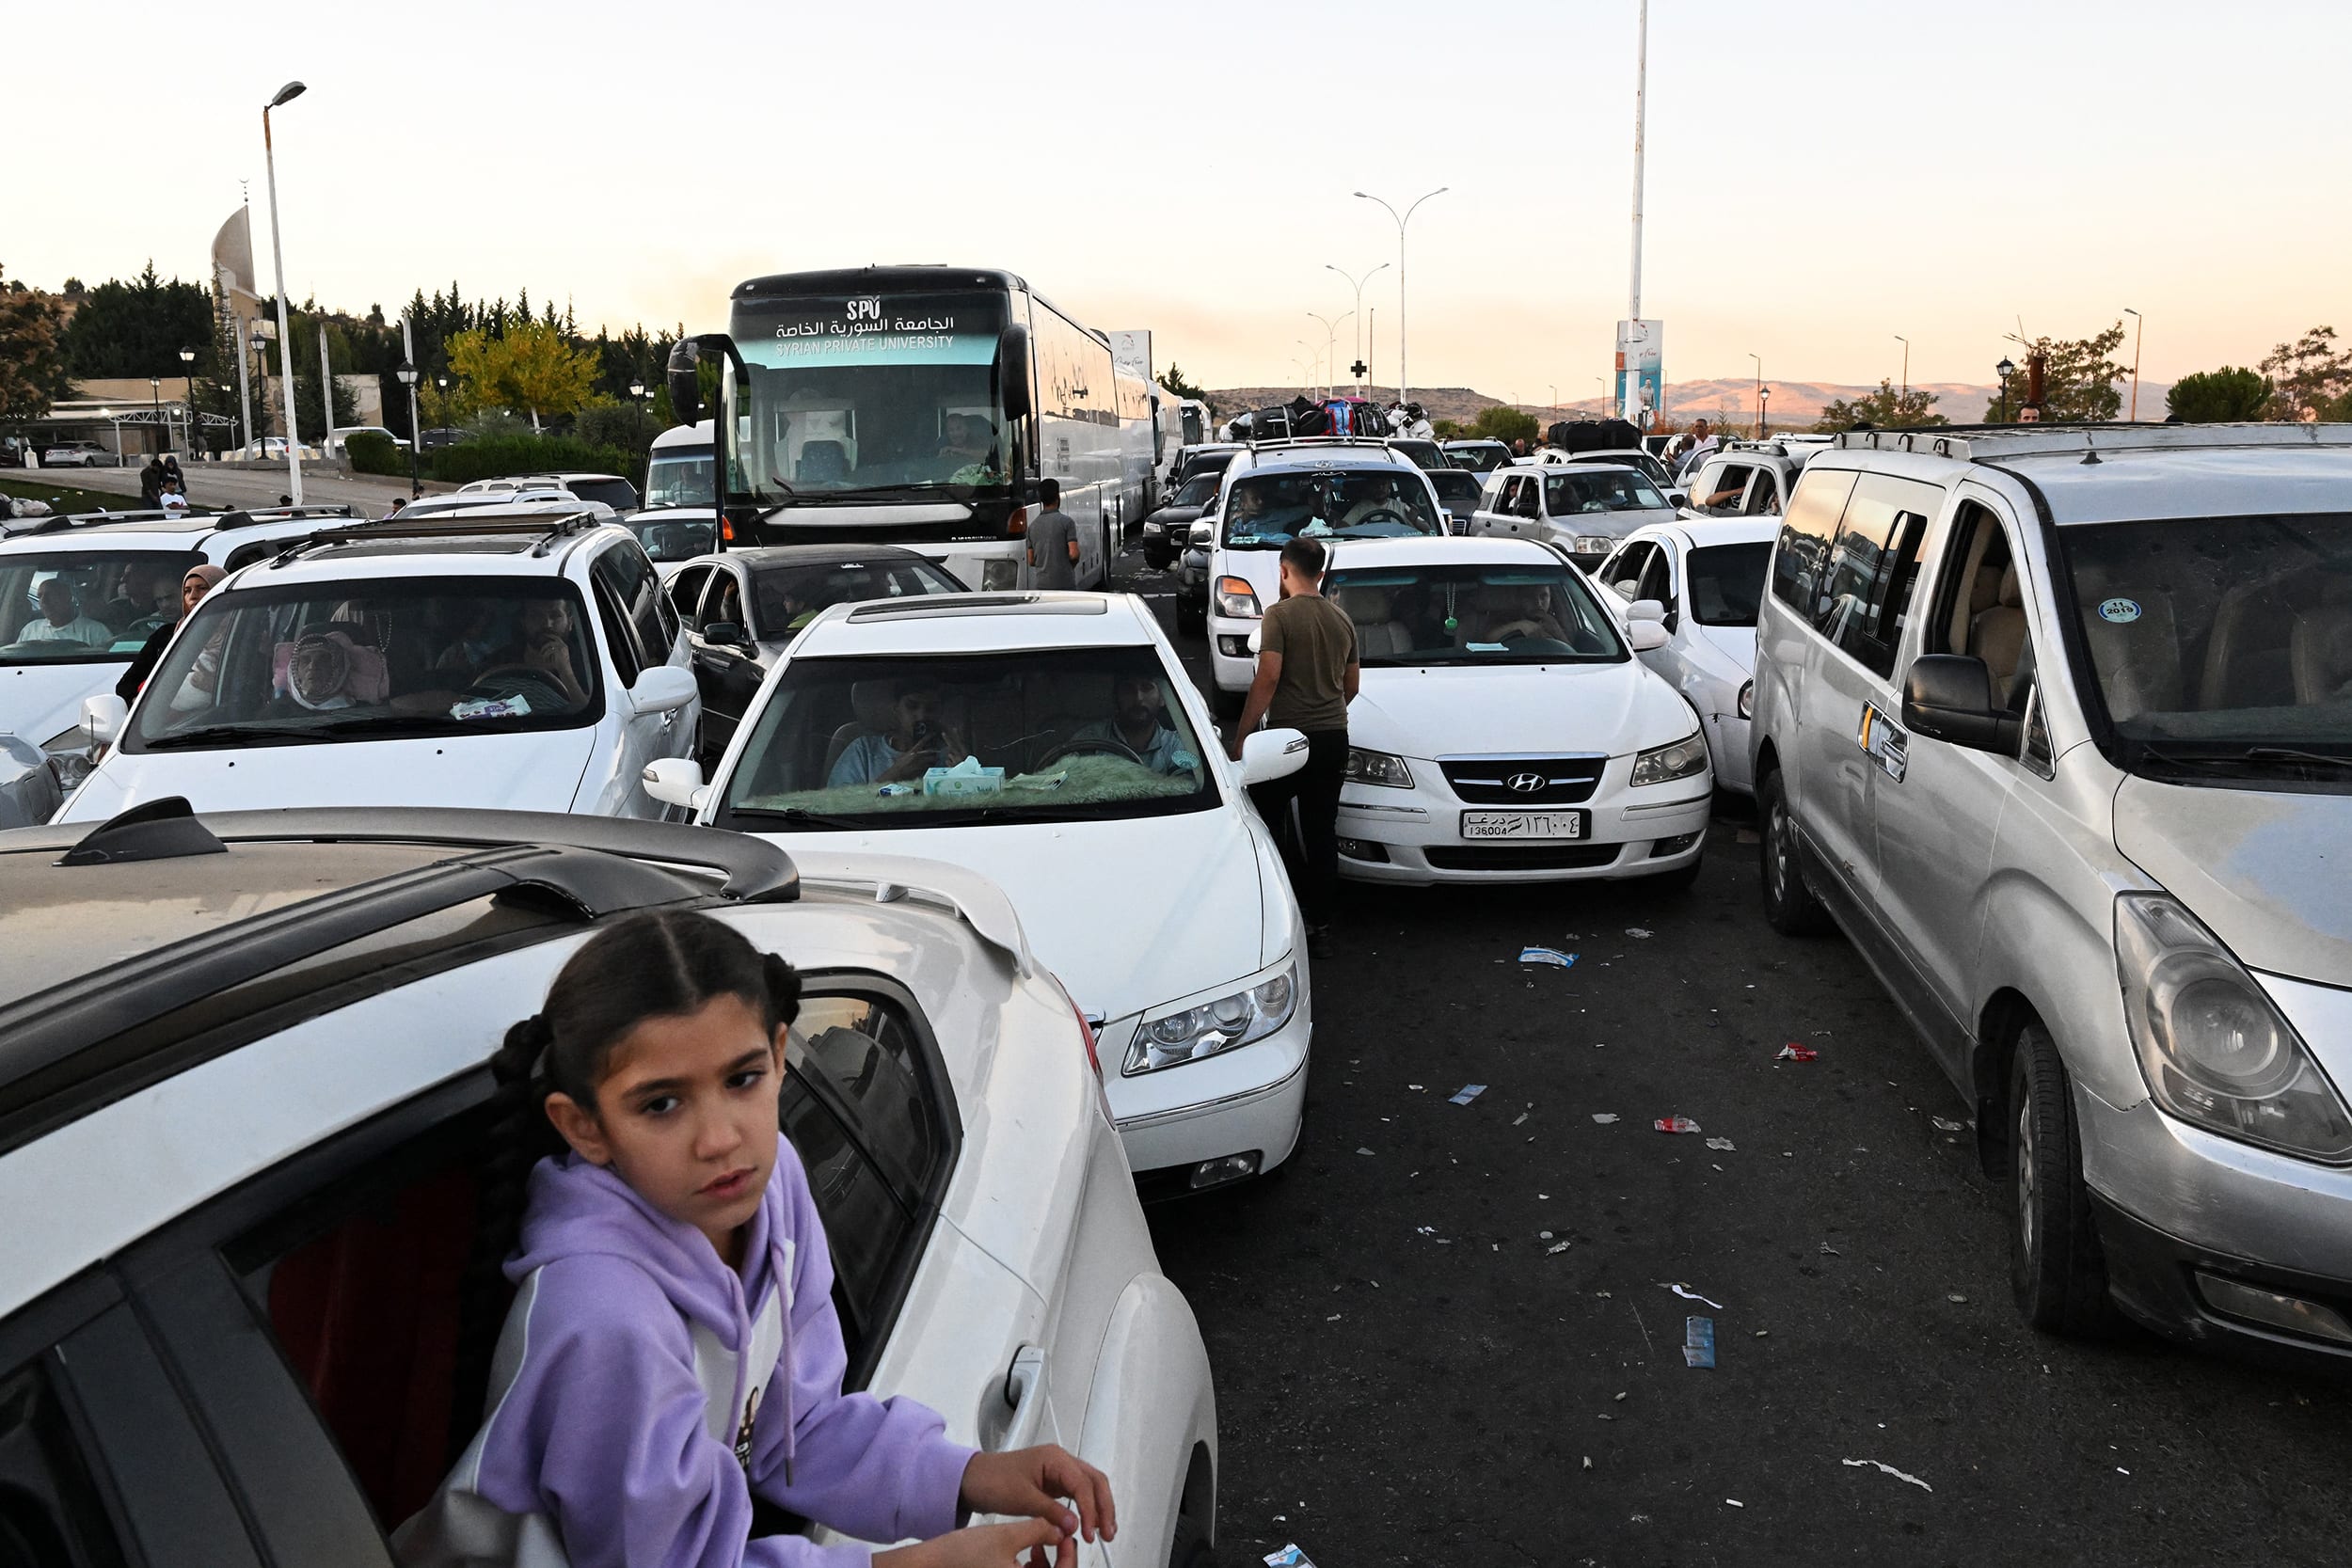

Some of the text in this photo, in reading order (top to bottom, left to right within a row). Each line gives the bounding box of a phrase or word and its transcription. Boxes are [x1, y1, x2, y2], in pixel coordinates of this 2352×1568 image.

[847, 294, 881, 321] SPU
[775, 316, 954, 338] الجامعة السورية الخاصة
[775, 335, 954, 356] SYRIAN PRIVATE UNIVERSITY
[1468, 815, 1506, 825] درعا
[1525, 816, 1578, 834] ١٣٦٠٠٤
